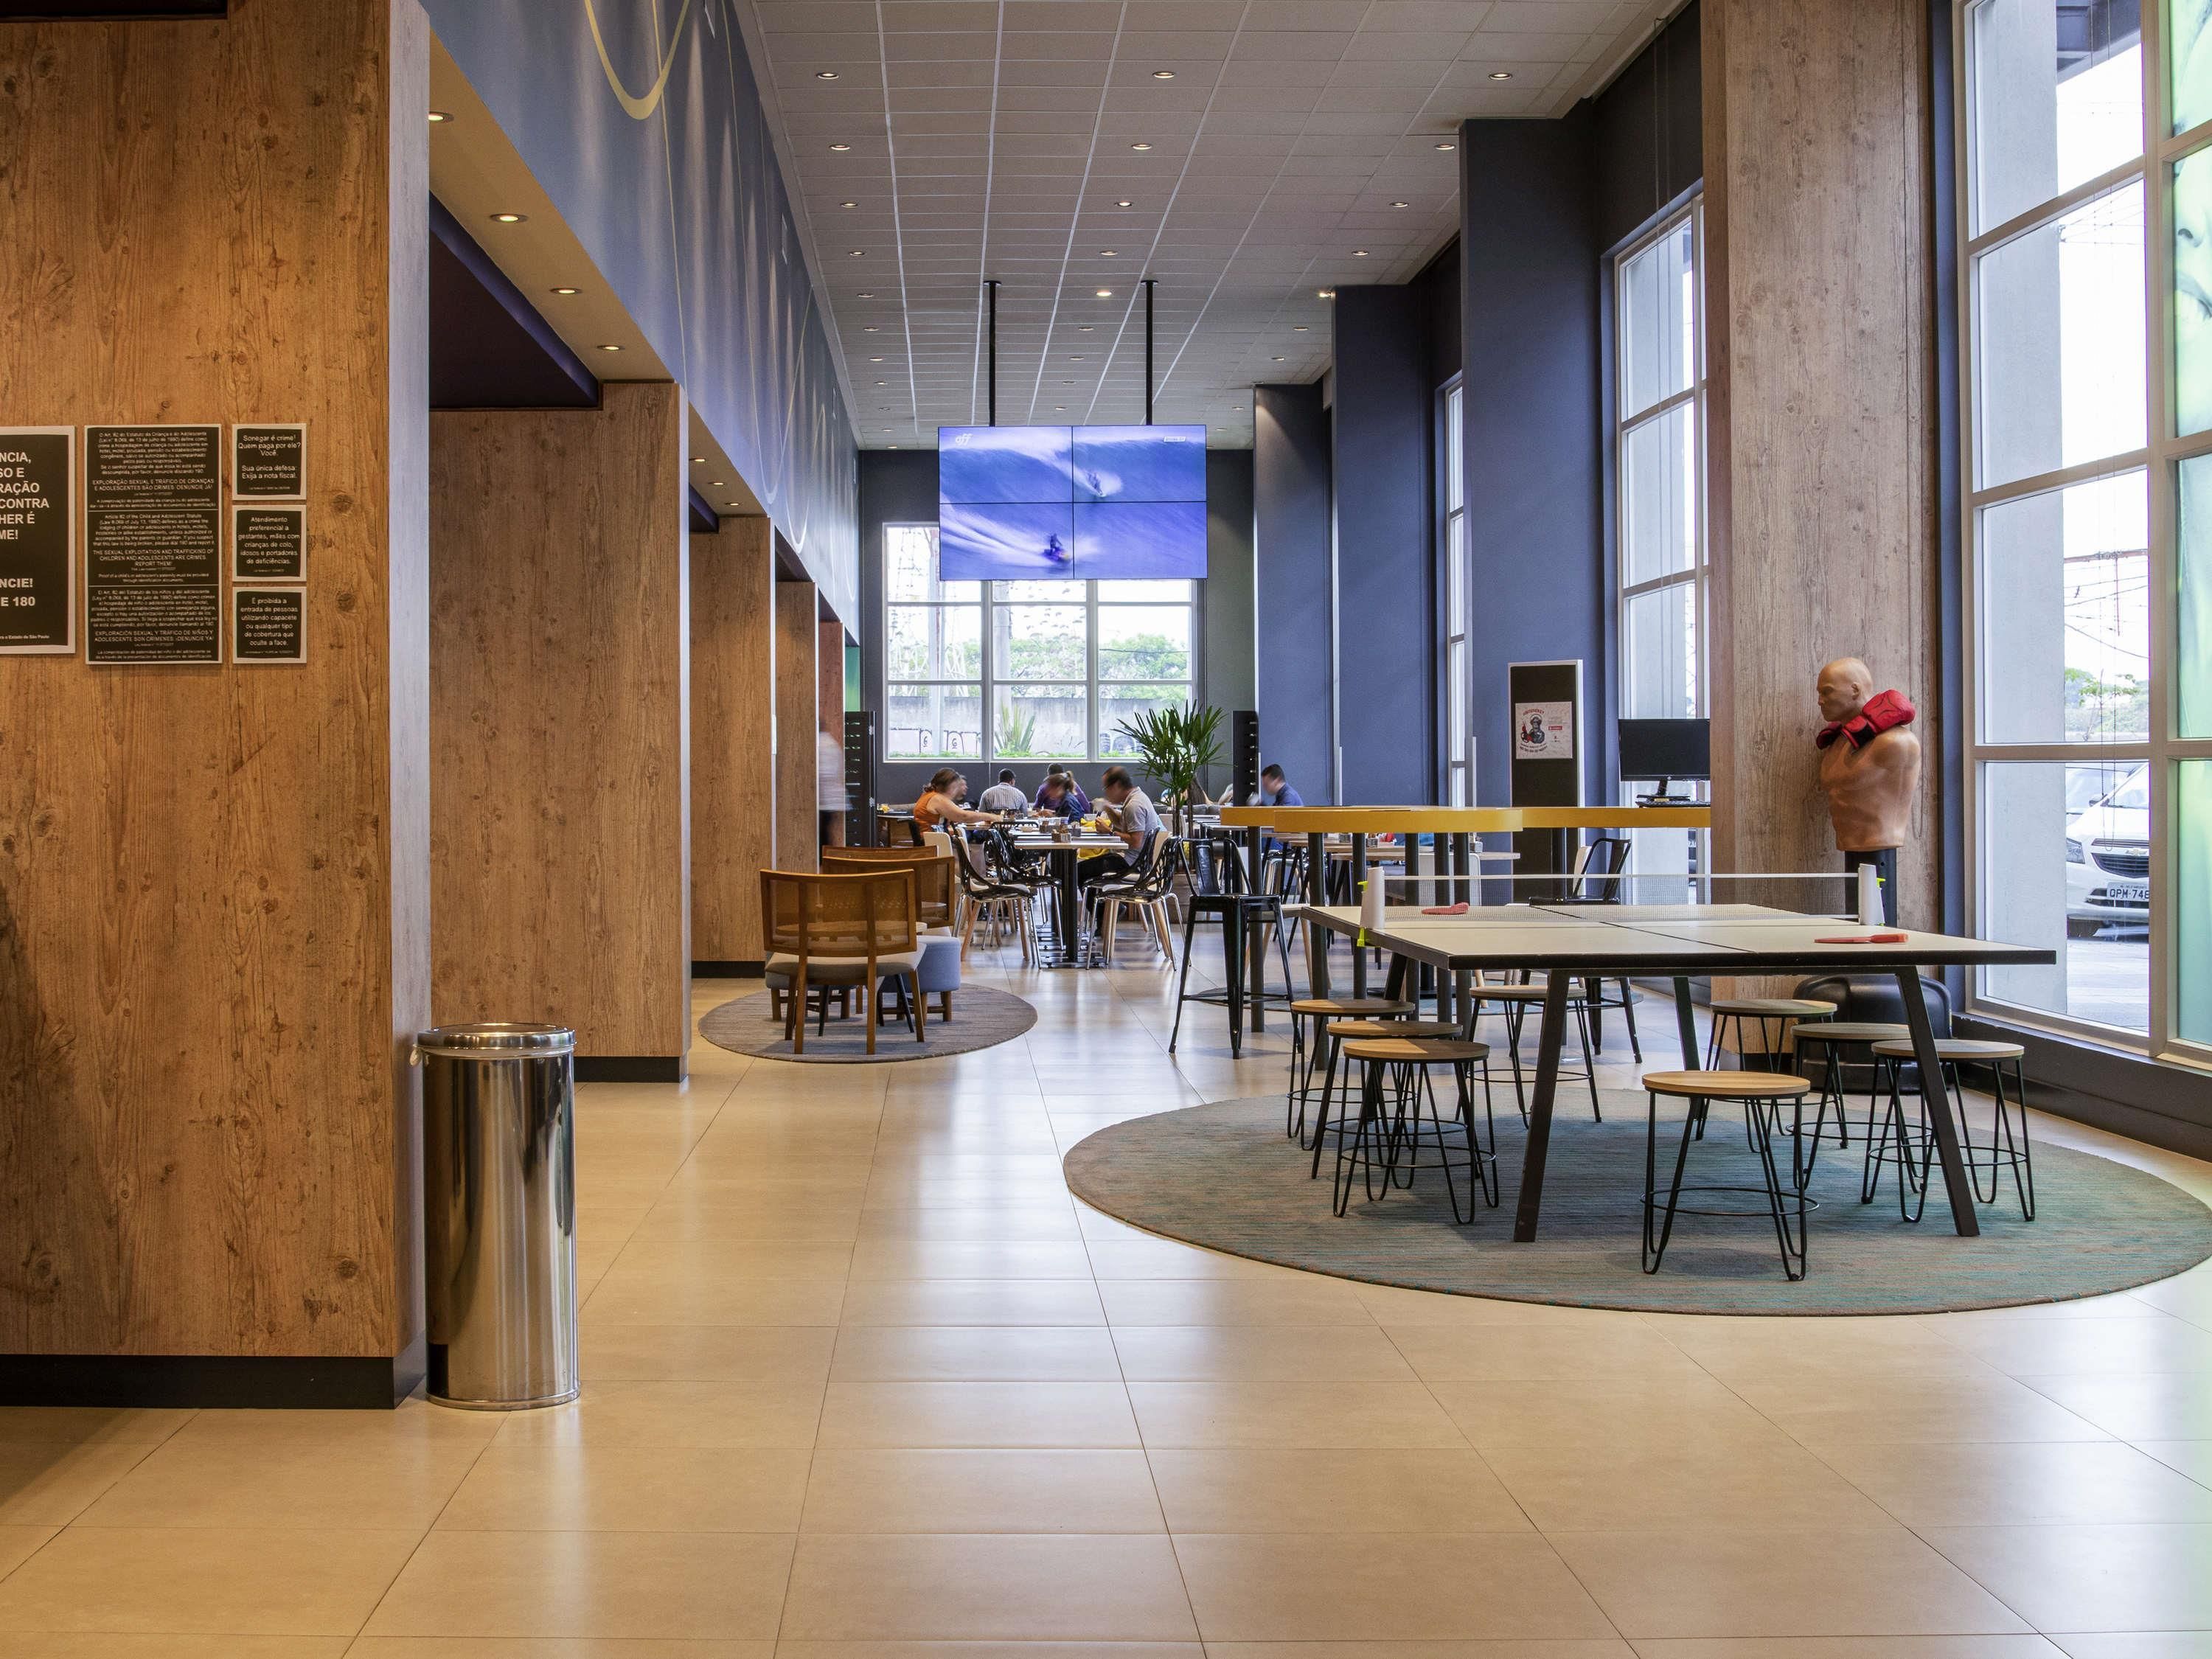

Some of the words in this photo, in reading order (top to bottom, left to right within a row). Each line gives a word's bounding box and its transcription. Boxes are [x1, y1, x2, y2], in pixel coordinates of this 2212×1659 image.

[955, 433, 972, 446] off
[0, 452, 31, 464] NCIA,
[17, 468, 24, 477] E
[0, 499, 49, 508] CONTRA
[27, 512, 35, 524] É
[0, 578, 33, 588] NCIE!
[1, 597, 9, 606] E
[13, 596, 35, 606] 180
